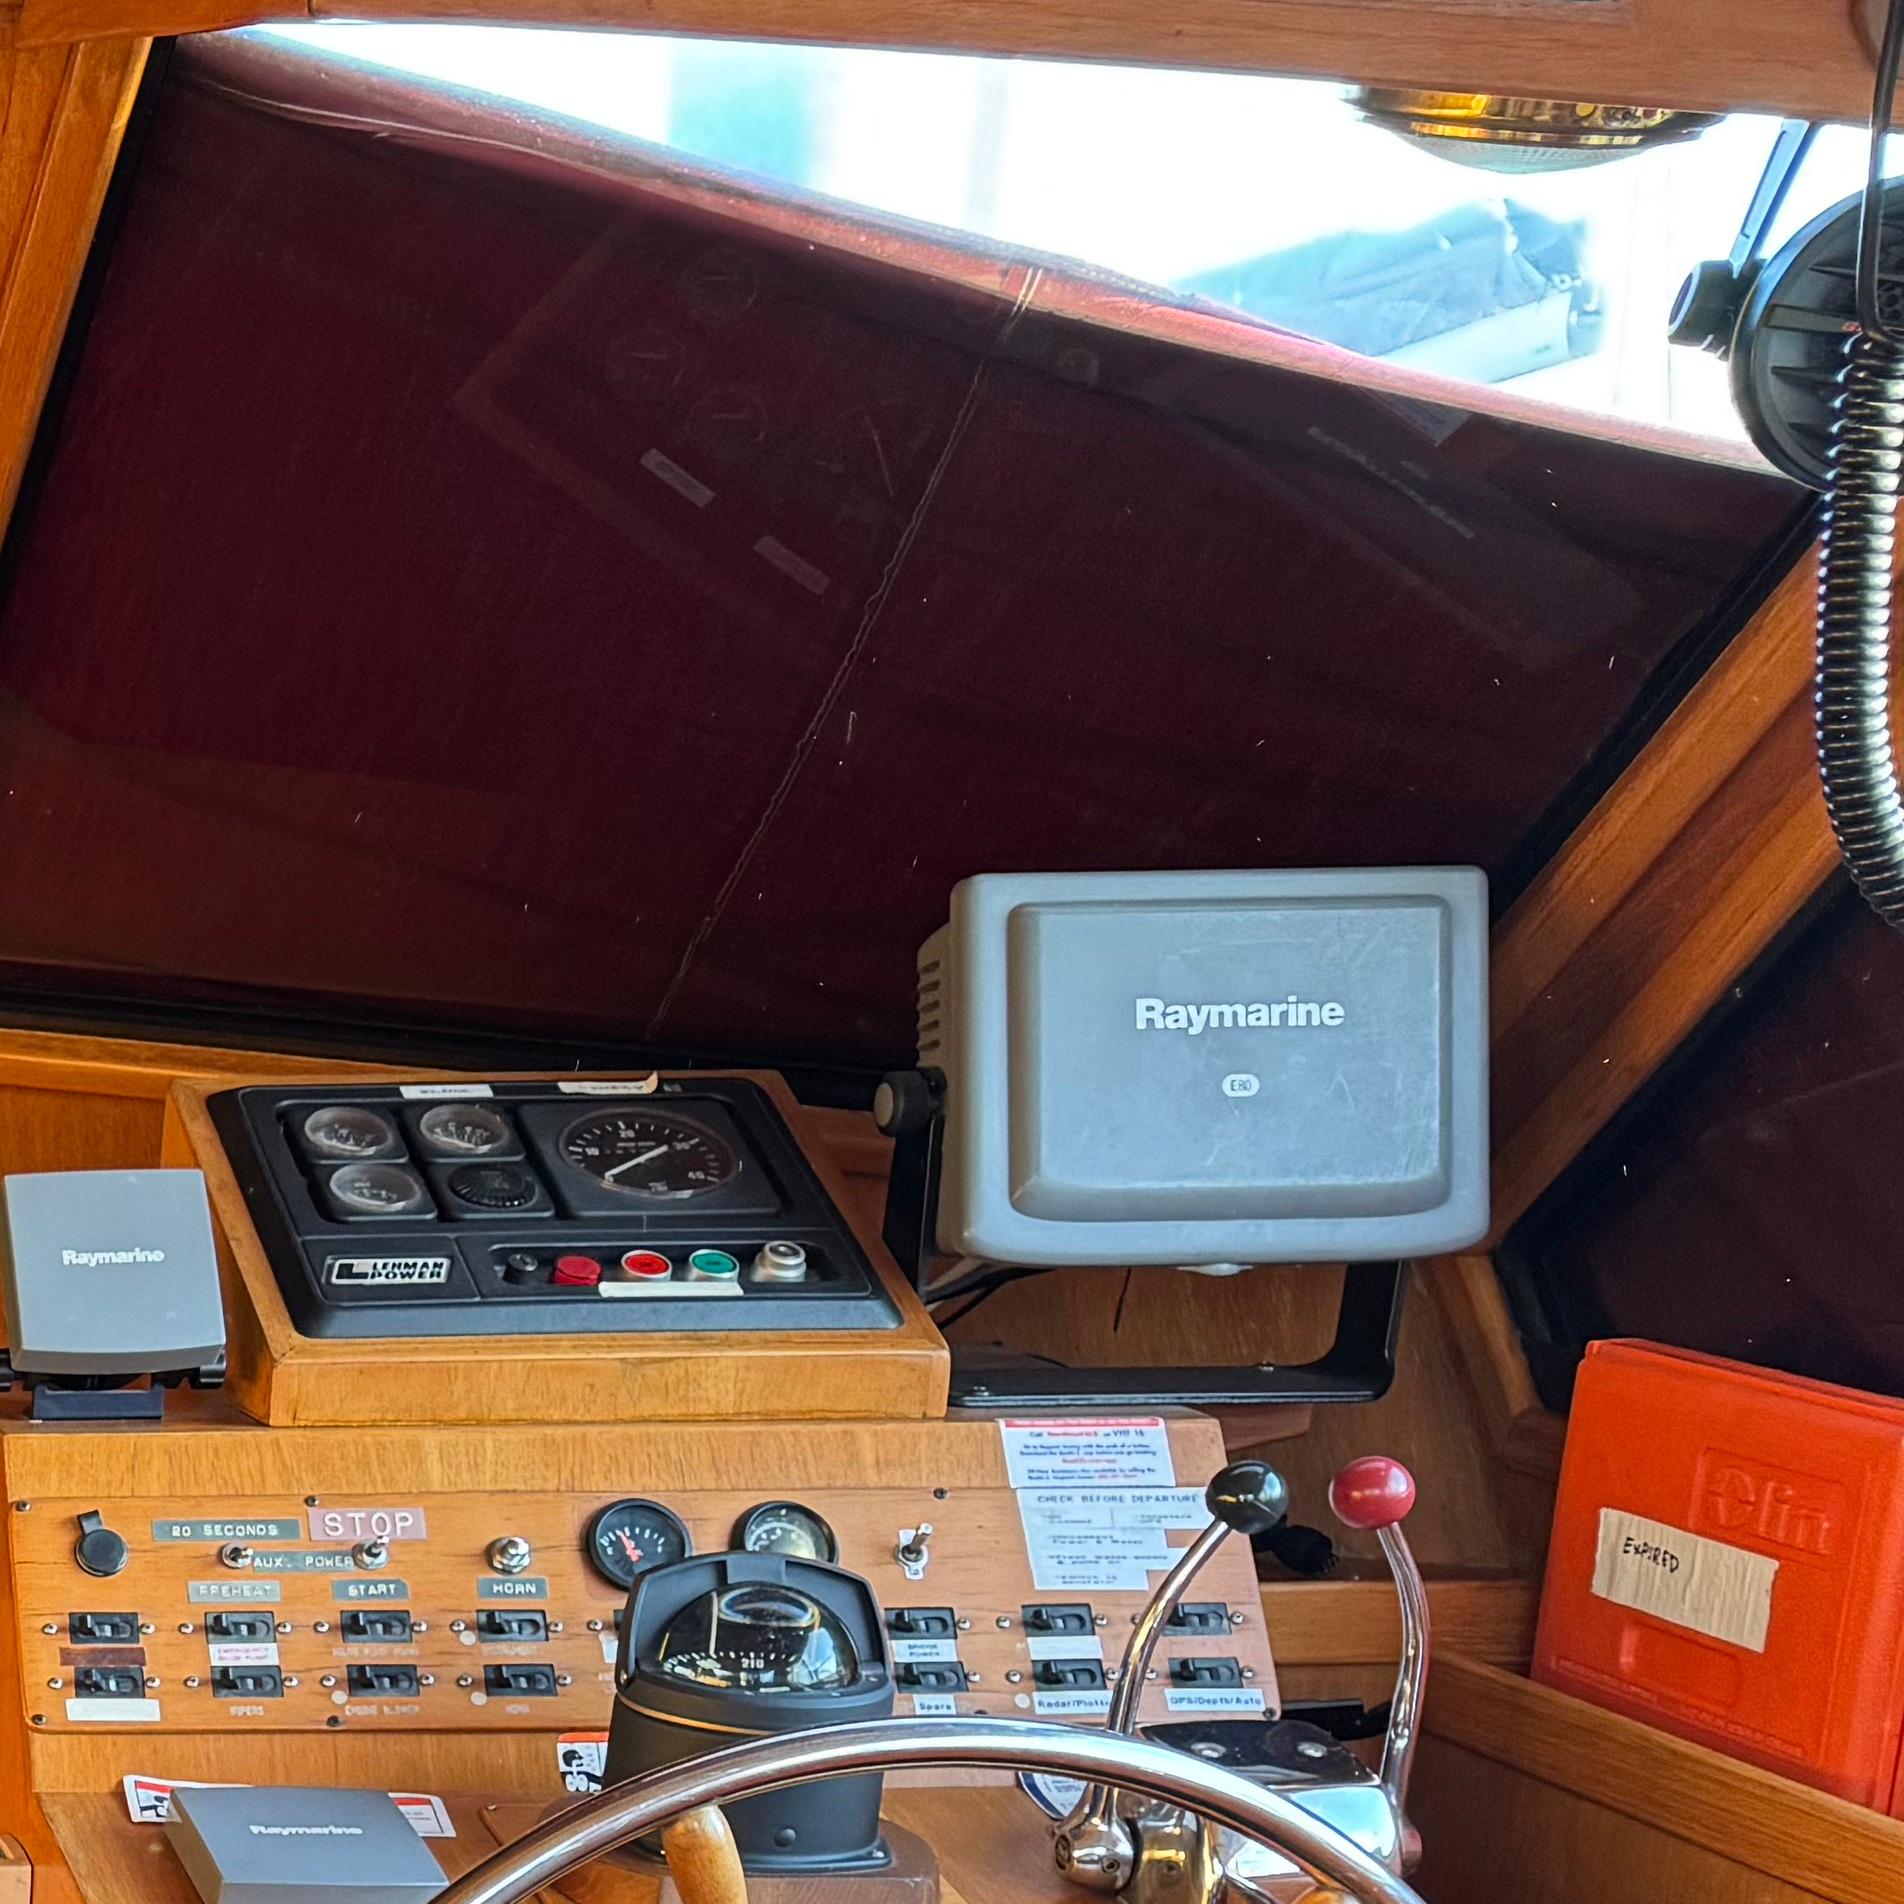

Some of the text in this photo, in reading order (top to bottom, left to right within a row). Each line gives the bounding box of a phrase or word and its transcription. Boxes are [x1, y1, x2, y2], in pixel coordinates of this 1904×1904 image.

[1135, 994, 1346, 1036] Raymarine
[62, 1247, 166, 1267] Raymarine
[371, 1261, 444, 1271] LEHMAN
[369, 1270, 443, 1281] POWER
[1037, 1494, 1199, 1504] CHECK BEFORE DEPARTURE
[171, 1524, 279, 1537] 20 SECONDS
[323, 1511, 414, 1537] STOP
[304, 1555, 355, 1568] POWER
[1622, 1535, 1681, 1575] EXPIRED
[347, 1583, 397, 1597] START
[492, 1582, 537, 1595] HORN
[741, 1657, 765, 1669] 210
[918, 1702, 952, 1712] Spare
[1169, 1695, 1262, 1709] GPS/Depth/Auto
[249, 1825, 363, 1836] Raymarine
